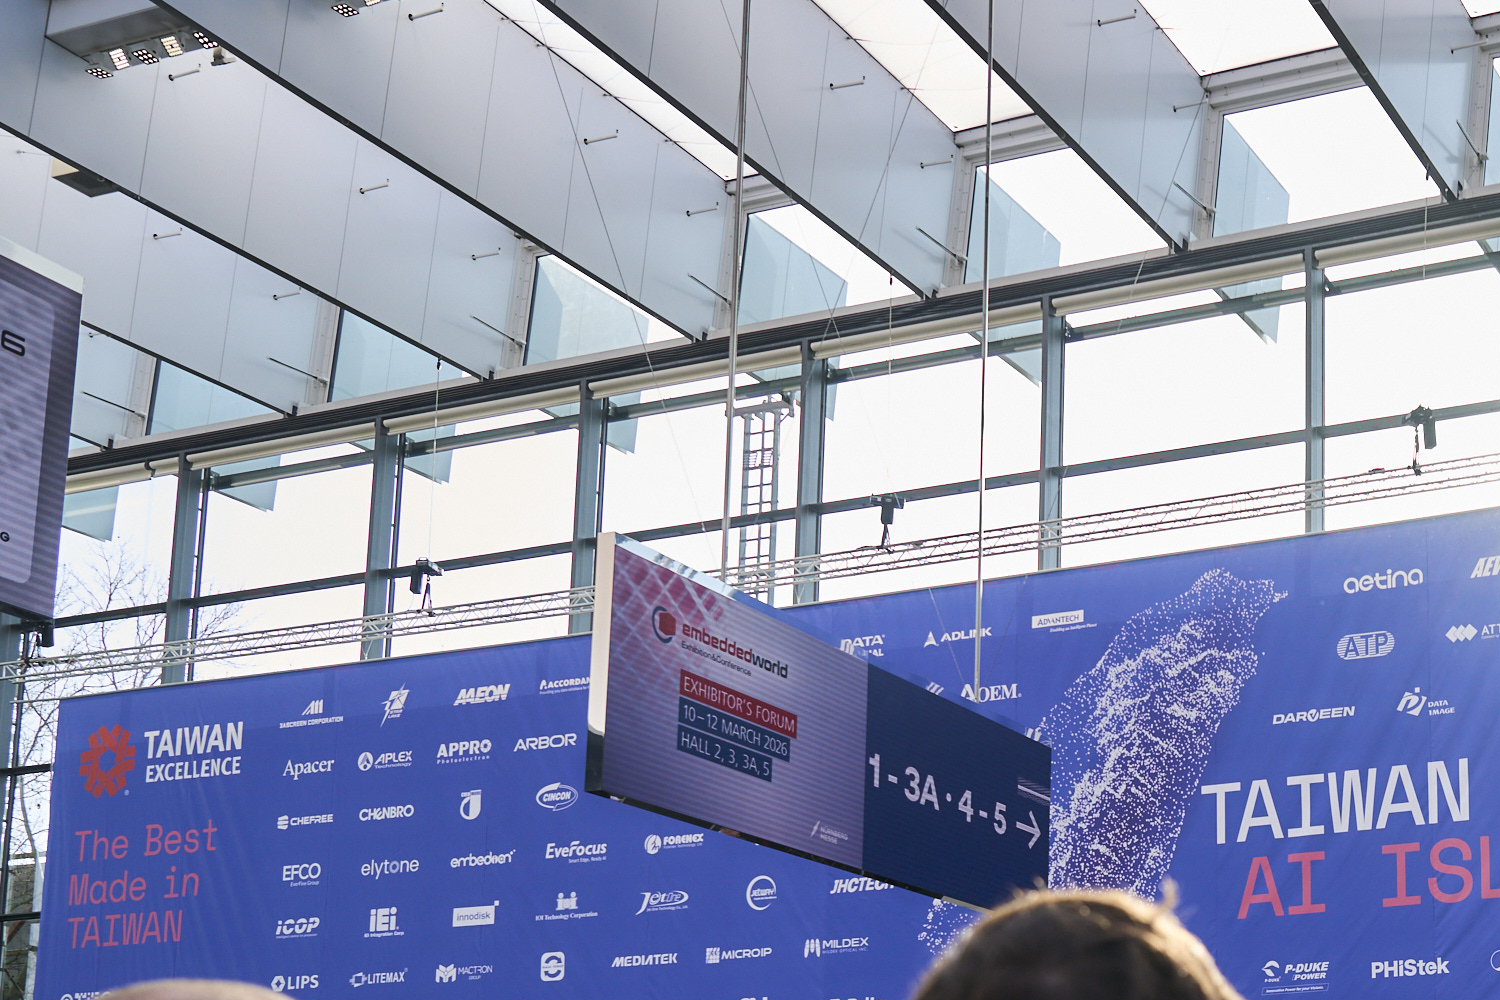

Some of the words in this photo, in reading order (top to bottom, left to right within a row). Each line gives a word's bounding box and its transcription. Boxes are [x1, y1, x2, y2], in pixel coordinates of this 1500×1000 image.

[1344, 569, 1423, 593] aetina
[755, 704, 796, 734] FORUM
[144, 722, 243, 760] TAIWAN
[514, 733, 577, 752] ARBOR
[681, 731, 711, 757] HALL
[721, 720, 761, 747] MARCH
[764, 735, 788, 757] 2026
[375, 751, 412, 766] APLEX
[437, 739, 491, 759] APPRO
[146, 755, 241, 782] EXCELLENCE
[283, 760, 334, 780] Apacer
[1200, 756, 1469, 845] TAIWAN
[290, 814, 333, 825] CHEFREE
[359, 805, 414, 821] CHENBRO
[75, 828, 129, 863] The
[143, 818, 218, 857] Best
[663, 834, 704, 847] FORENEX
[283, 863, 322, 881] EFCO
[361, 860, 419, 879] elytone
[68, 870, 147, 906] Made
[164, 865, 200, 899] in
[1237, 850, 1326, 920] AI
[456, 911, 491, 923] innodisk
[67, 909, 183, 949] TAIWAN
[822, 937, 869, 949] MILDEX
[612, 953, 677, 967] MEDIATEK
[721, 948, 772, 959] MICROIP
[1284, 961, 1330, 974] P-DUKE
[1294, 972, 1327, 981] POWER
[287, 975, 319, 990] LIPS
[366, 972, 405, 984] LITEMAX
